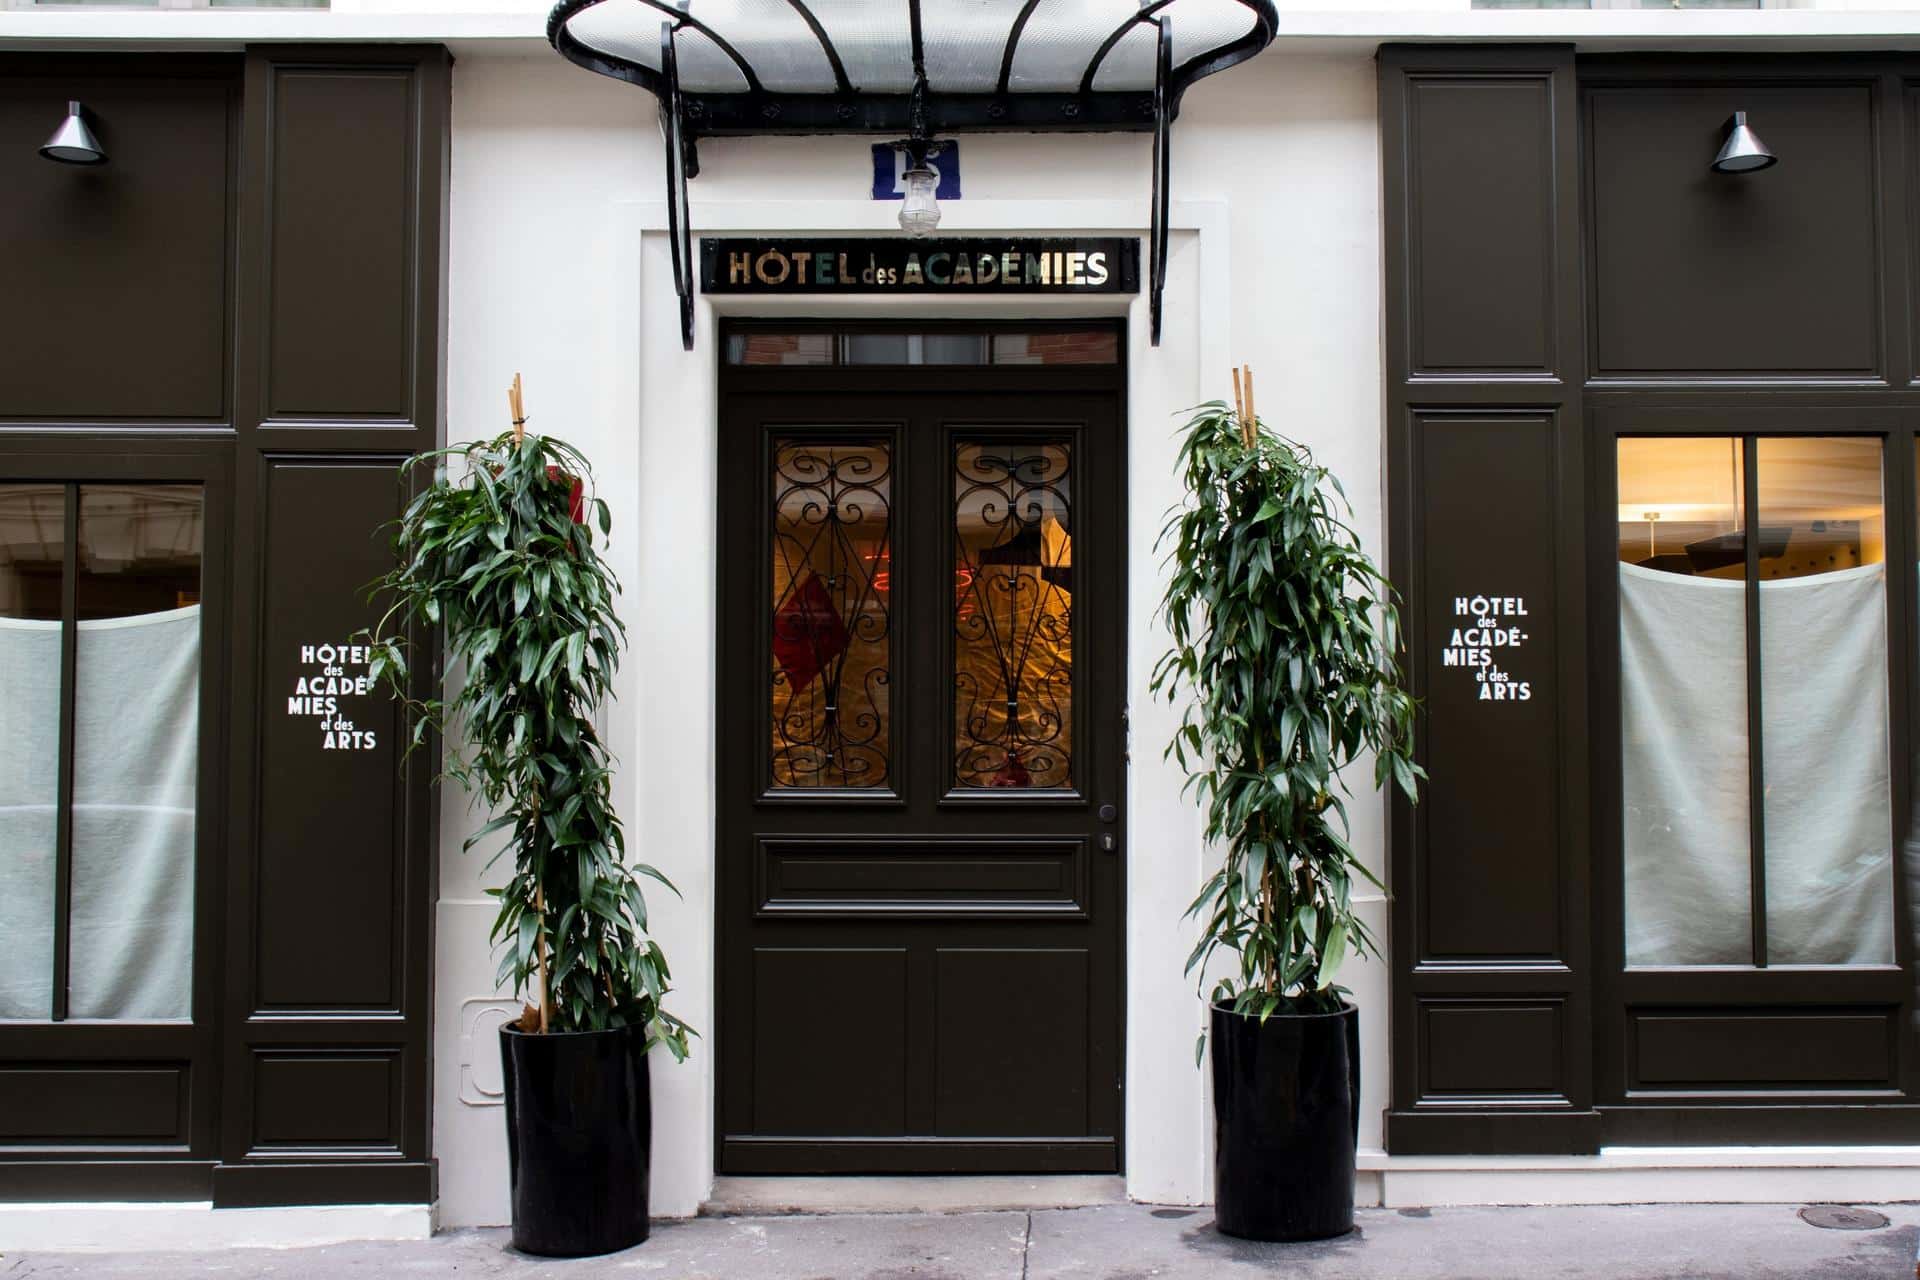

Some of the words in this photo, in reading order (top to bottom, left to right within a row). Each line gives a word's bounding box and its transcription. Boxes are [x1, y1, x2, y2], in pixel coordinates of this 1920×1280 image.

[729, 247, 857, 285] HÔTEL
[862, 252, 896, 285] des
[902, 246, 1109, 285] ACADÉMIES
[1455, 594, 1528, 616] HÔTEL
[1477, 614, 1497, 628] des
[1450, 626, 1529, 647] ACADÉ-
[1443, 648, 1492, 666] MIES
[323, 662, 343, 676] des
[1475, 664, 1487, 682] et
[1489, 664, 1509, 682] des
[1479, 682, 1531, 701] ARTS
[288, 697, 337, 715] MIES
[320, 713, 331, 731] et
[333, 713, 354, 731] des
[323, 731, 376, 750] ARTS
